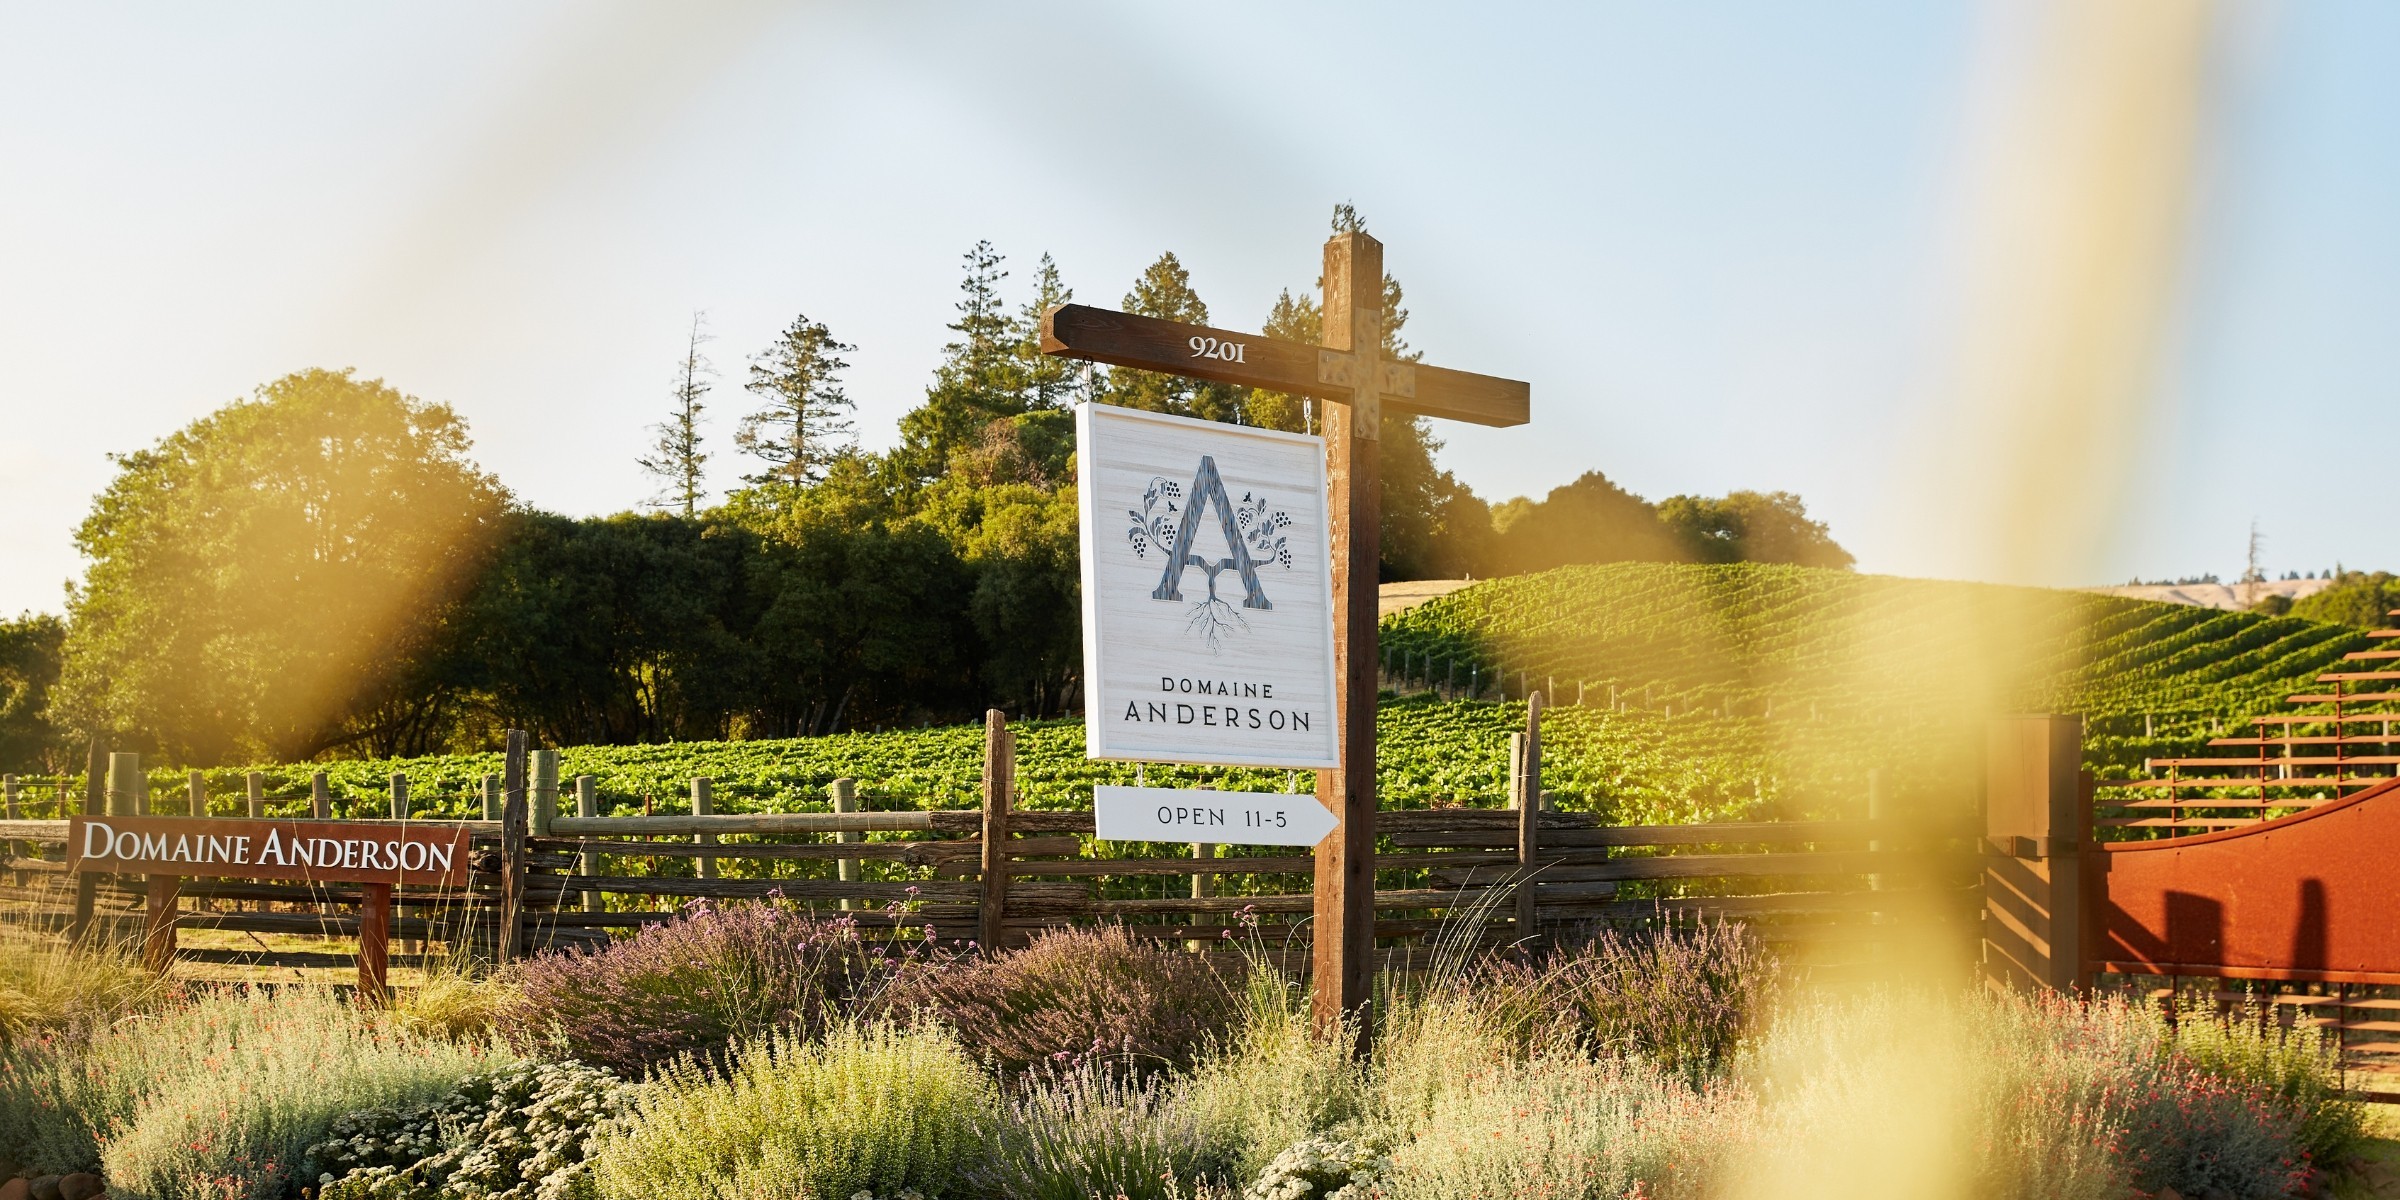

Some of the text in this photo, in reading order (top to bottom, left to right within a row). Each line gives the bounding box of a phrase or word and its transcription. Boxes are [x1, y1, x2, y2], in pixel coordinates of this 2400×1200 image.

[1188, 336, 1246, 364] 9201
[1152, 455, 1273, 610] A
[1161, 677, 1273, 699] DOMAINE
[1124, 700, 1310, 732] ANDERSON
[1157, 806, 1287, 828] OPEN 11-5
[82, 821, 455, 872] DOMAINE ANDERSON
